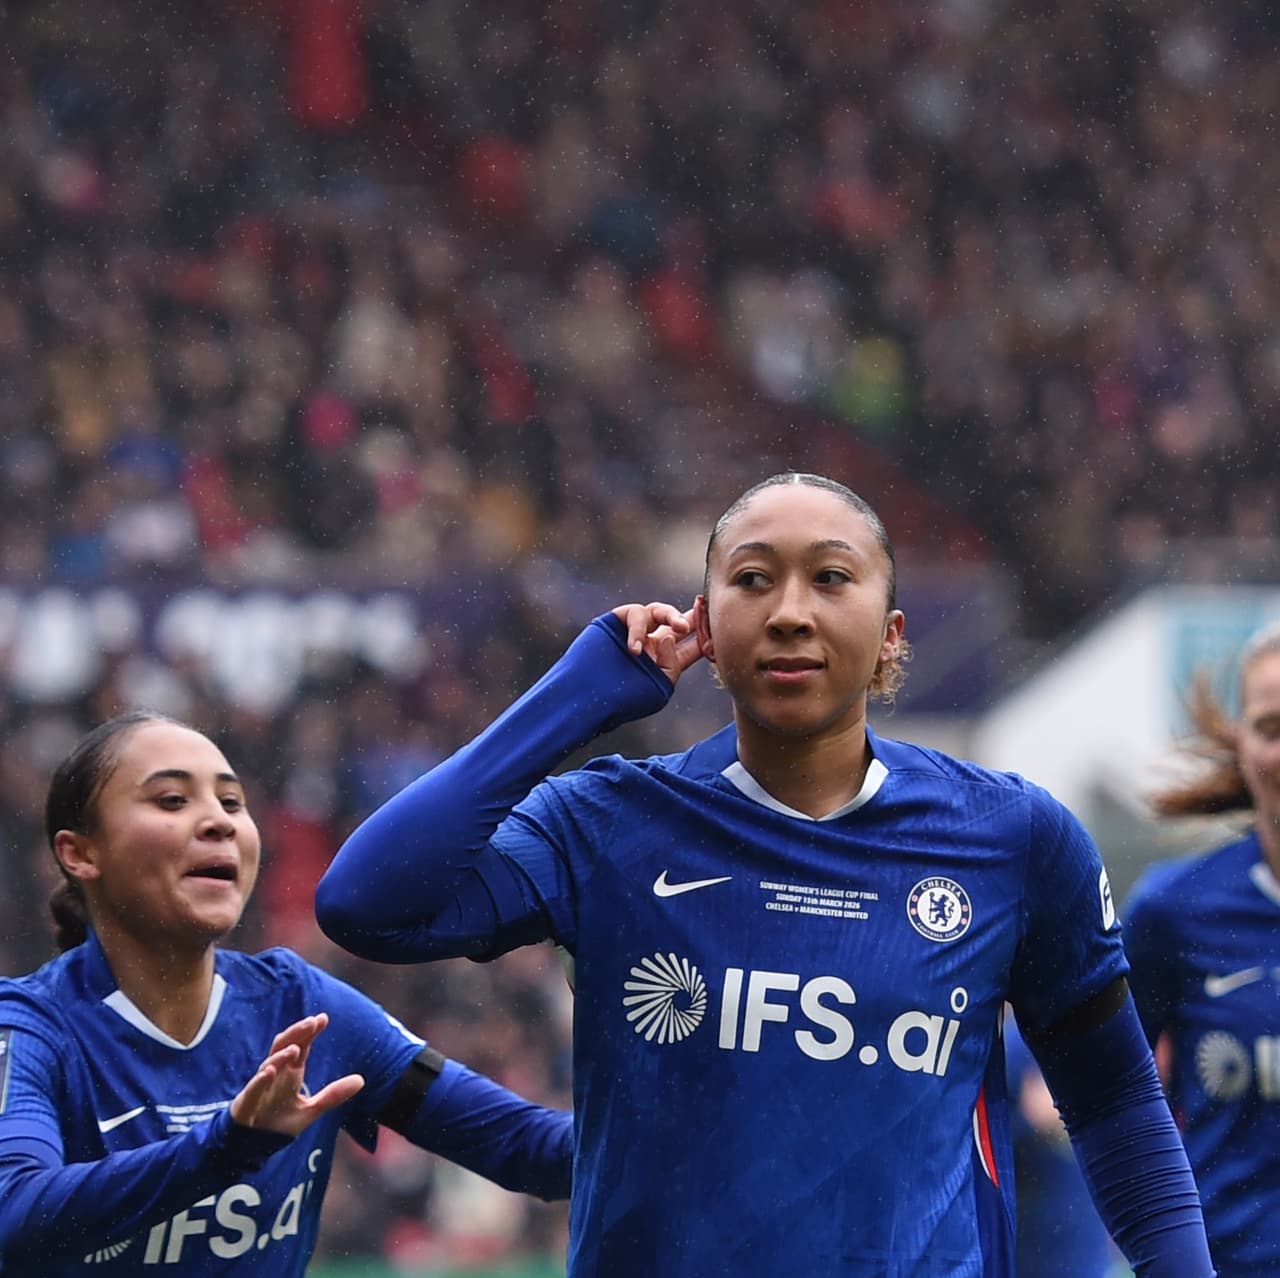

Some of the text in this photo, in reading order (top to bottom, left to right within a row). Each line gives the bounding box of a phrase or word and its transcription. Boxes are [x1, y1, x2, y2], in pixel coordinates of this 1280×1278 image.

[760, 881, 879, 901] SUBWAY WOMEN'S LEAGUE CUP FINAL
[921, 880, 961, 898] CHELSEA
[776, 893, 802, 903] SUNDAY
[819, 898, 843, 908] MARCH
[765, 902, 793, 913] CHELSEA
[799, 906, 843, 918] MANCHESTER
[844, 910, 869, 920] UNITED
[718, 967, 968, 1077] IFS.ai
